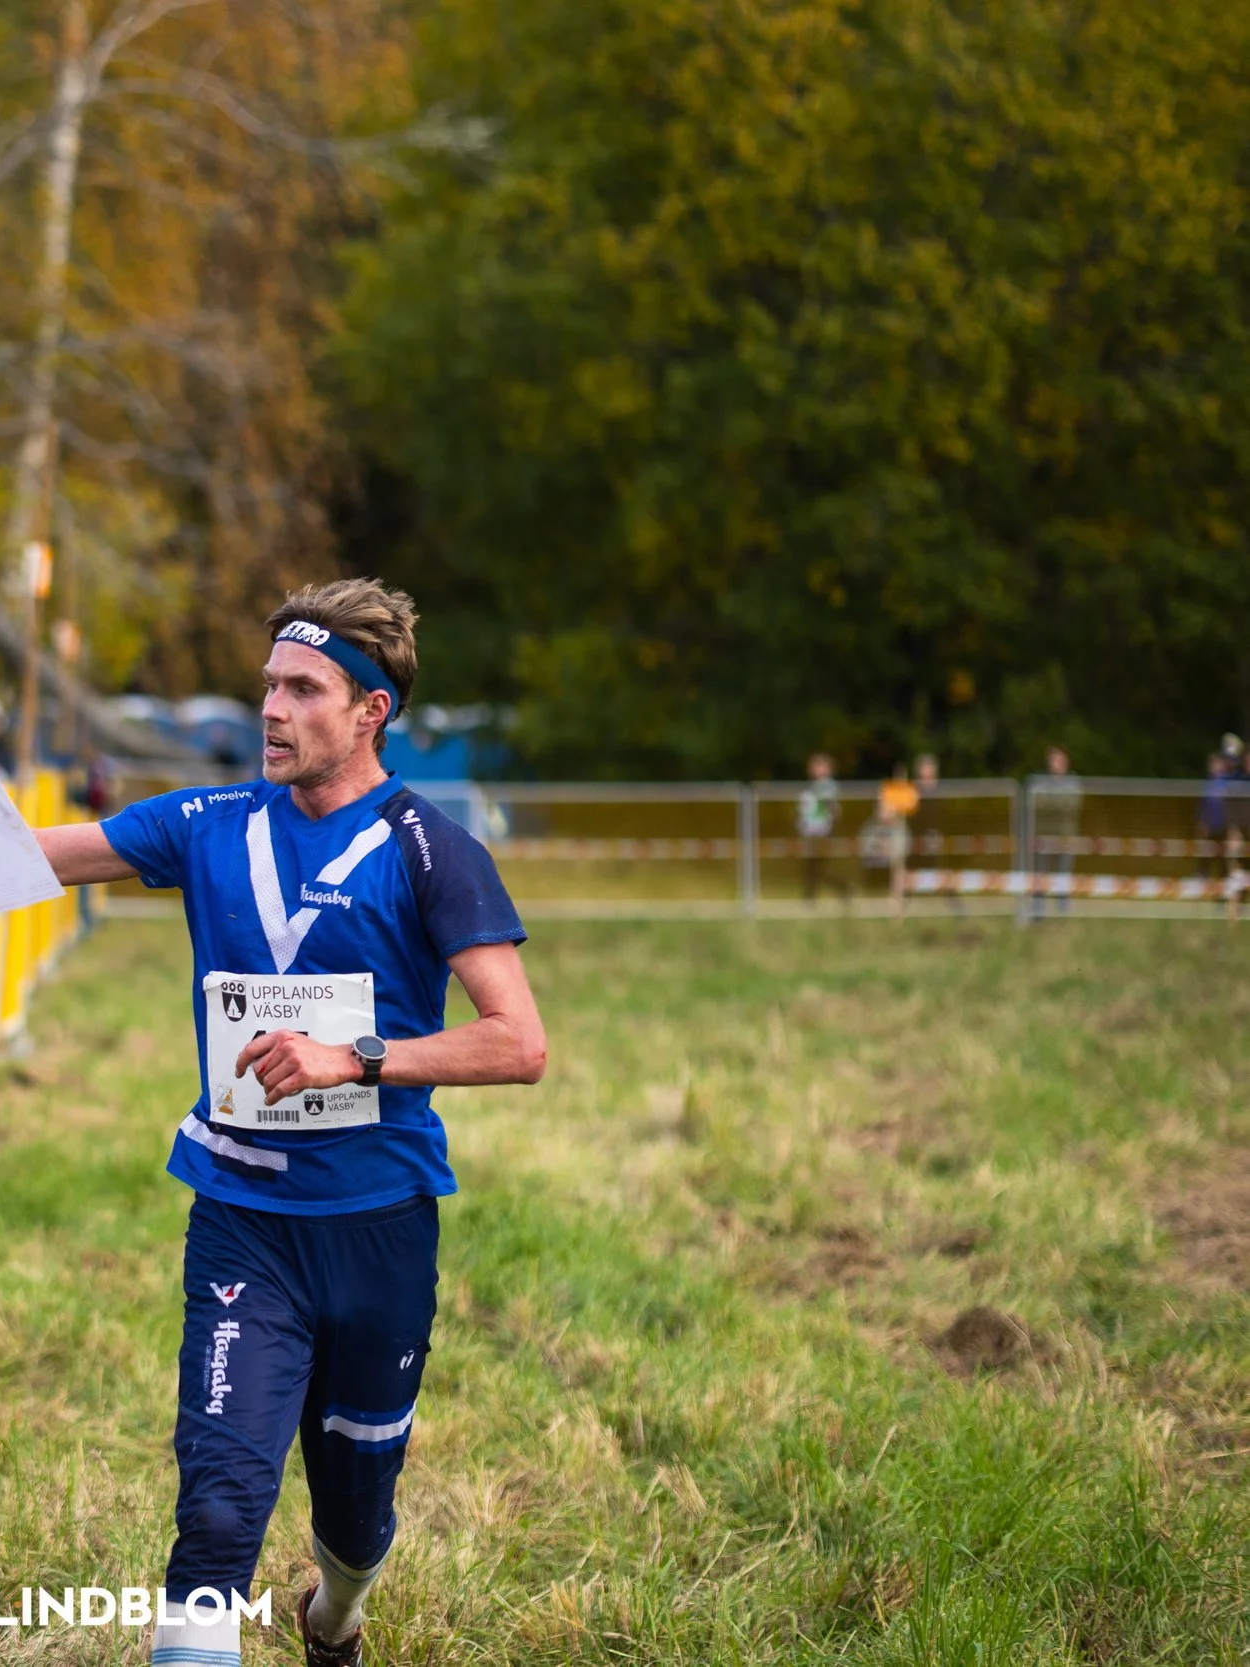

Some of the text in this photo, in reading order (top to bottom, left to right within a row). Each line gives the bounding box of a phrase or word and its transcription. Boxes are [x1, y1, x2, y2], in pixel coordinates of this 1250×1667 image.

[208, 790, 256, 805] Moelve
[411, 824, 432, 872] Moelven
[251, 985, 334, 1000] UPPLANDS
[253, 1002, 302, 1019] VÄSBY
[327, 1089, 372, 1102] UPPLANDS
[328, 1101, 355, 1112] VÄSBY
[205, 1318, 241, 1415] Hagaby
